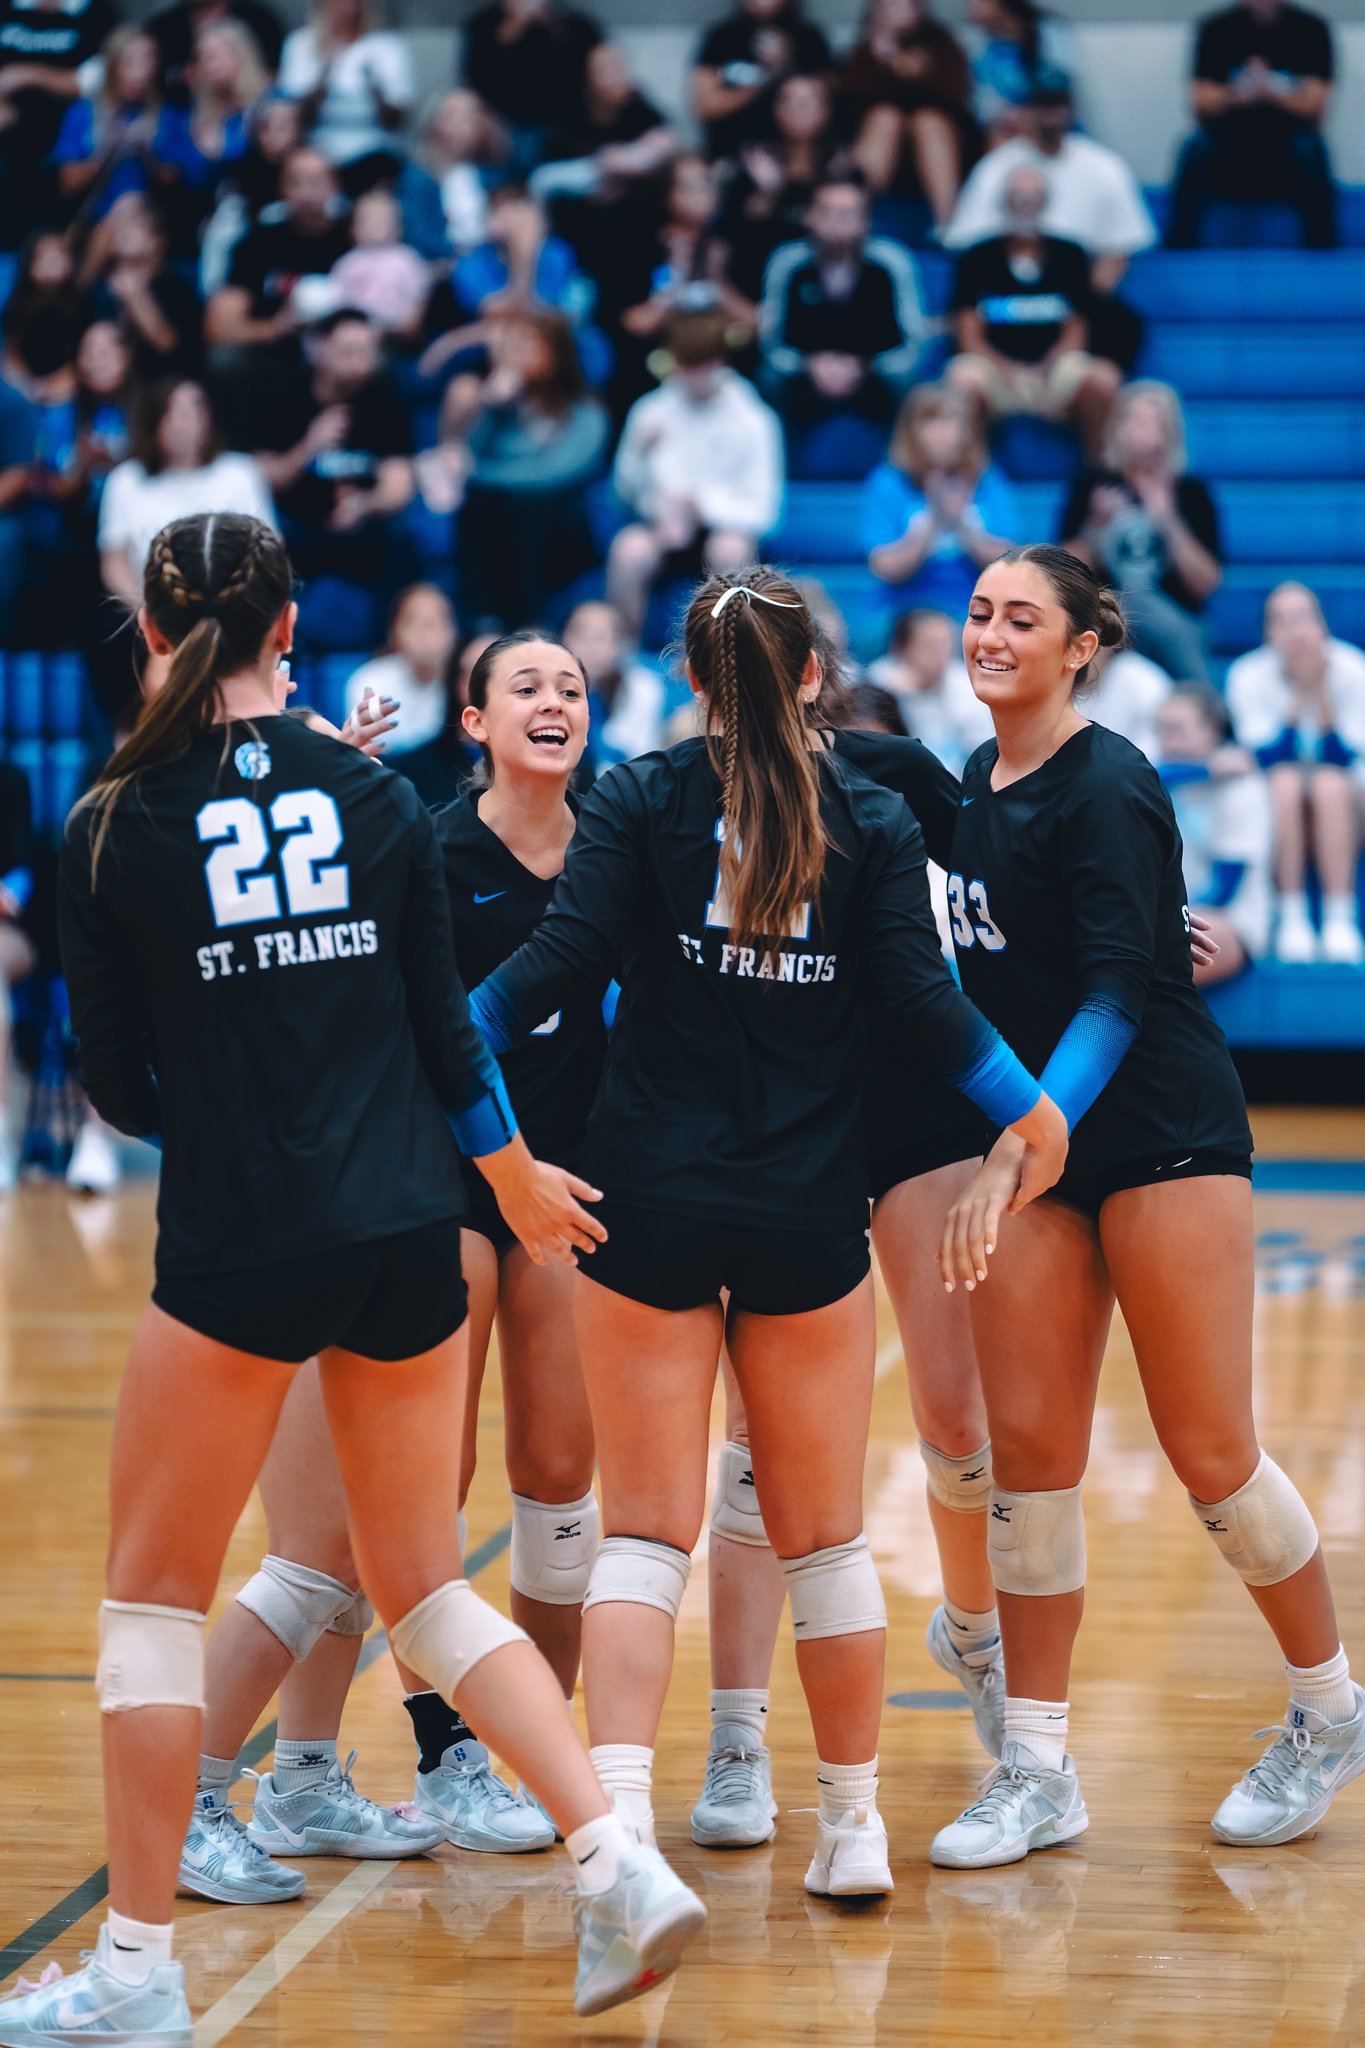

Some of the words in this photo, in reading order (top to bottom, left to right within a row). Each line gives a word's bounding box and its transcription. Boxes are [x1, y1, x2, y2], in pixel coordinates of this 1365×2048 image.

[195, 788, 350, 929] 22
[947, 871, 1008, 952] 33
[196, 941, 247, 981] ST.
[254, 919, 379, 970] FRANCIS
[719, 943, 837, 983] FRANCIS
